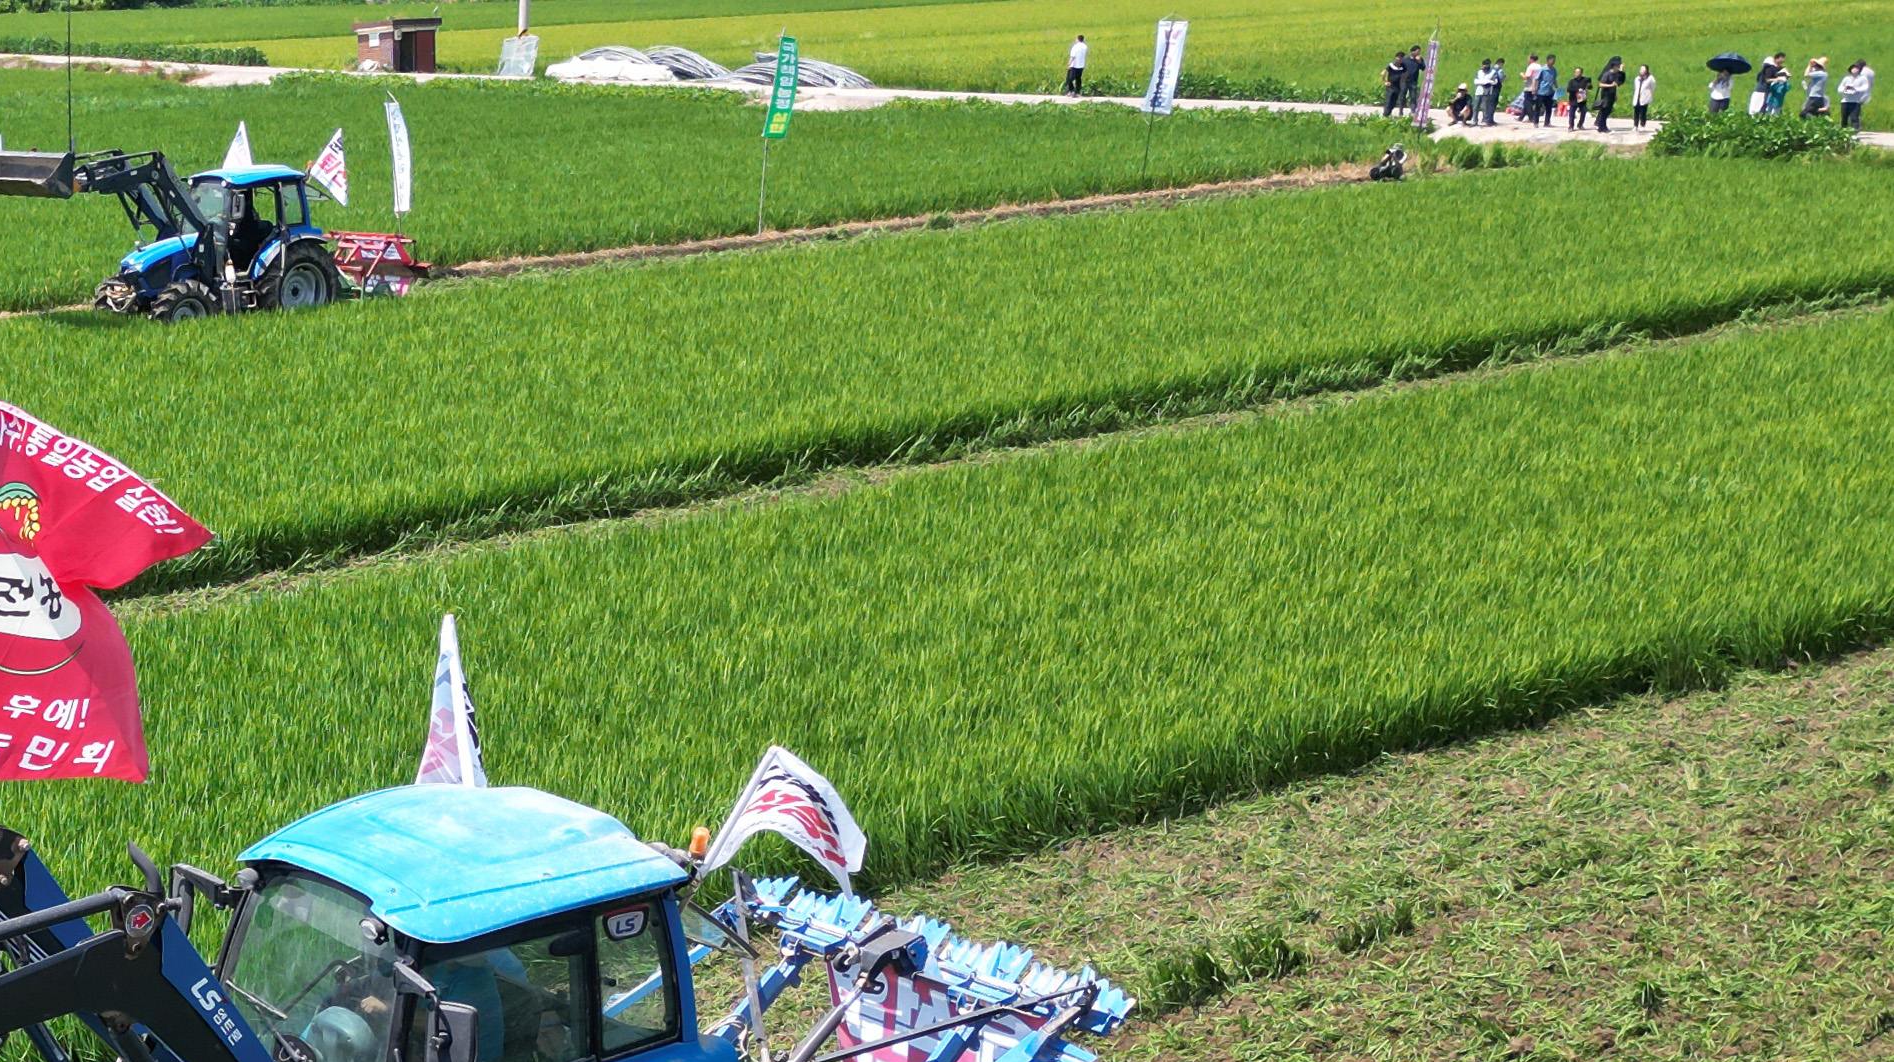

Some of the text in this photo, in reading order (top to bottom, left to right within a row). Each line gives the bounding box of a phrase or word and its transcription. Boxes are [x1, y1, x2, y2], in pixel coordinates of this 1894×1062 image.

[26, 423, 128, 493] 통일농업
[115, 485, 185, 534] 실현!
[2, 694, 91, 731] 후예!
[615, 917, 636, 935] LS
[191, 977, 222, 1011] LS
